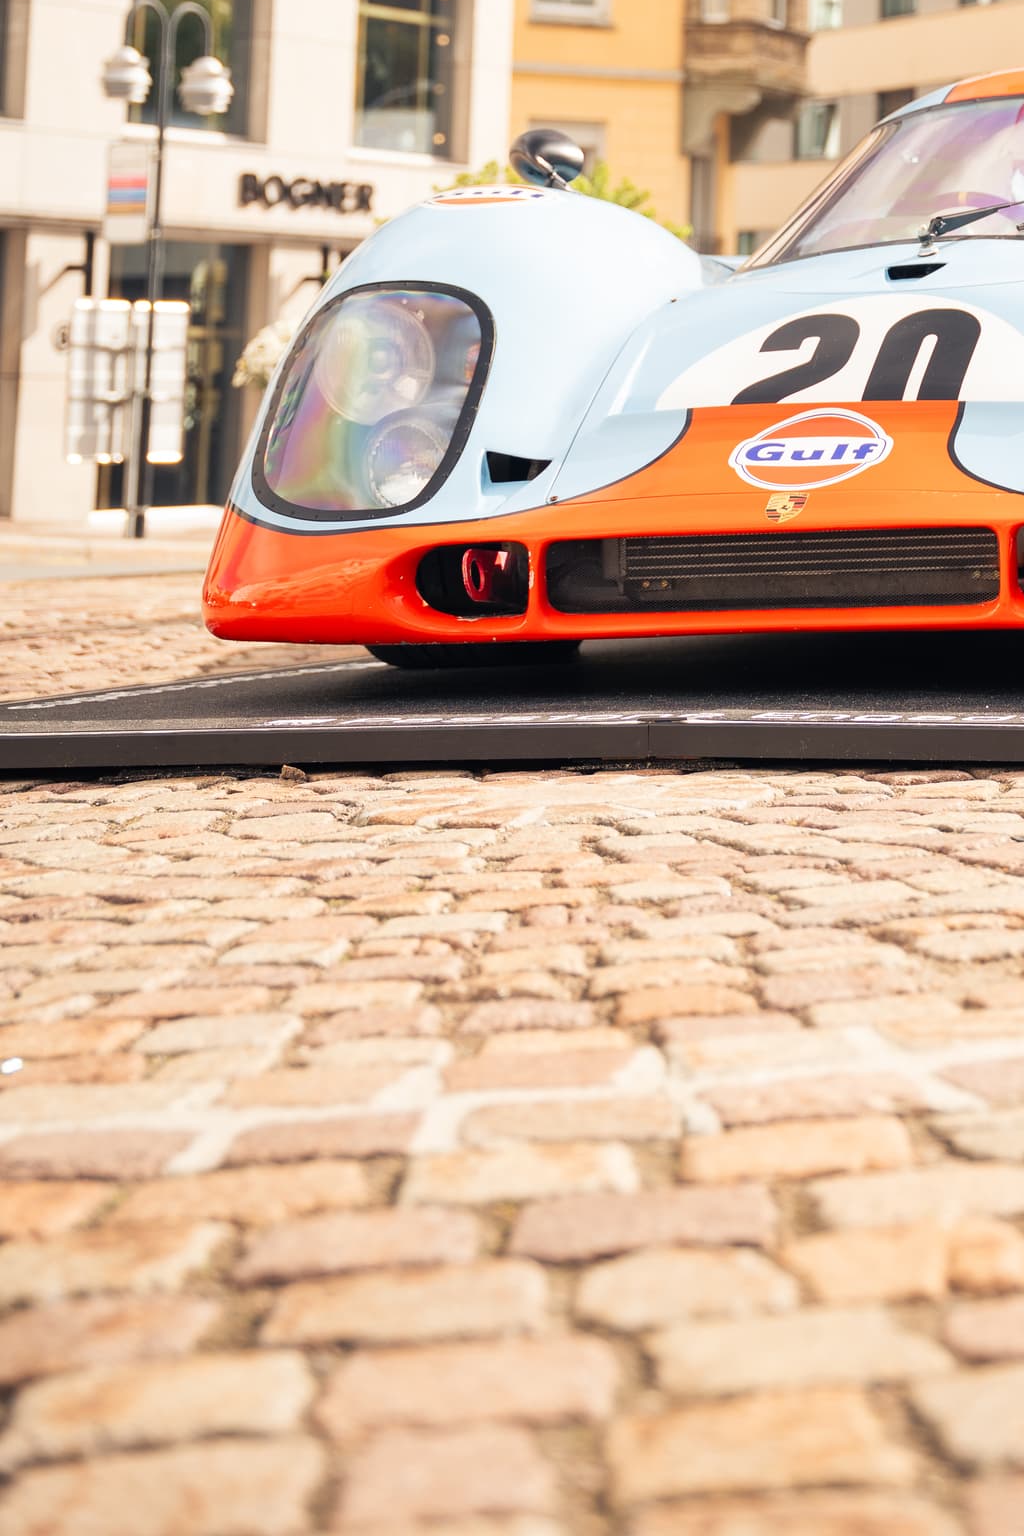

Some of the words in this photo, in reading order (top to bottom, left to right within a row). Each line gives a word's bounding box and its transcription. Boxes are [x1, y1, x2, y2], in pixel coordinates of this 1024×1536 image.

[239, 174, 374, 212] BOGNER
[730, 308, 982, 406] 20
[745, 442, 879, 462] Gulf
